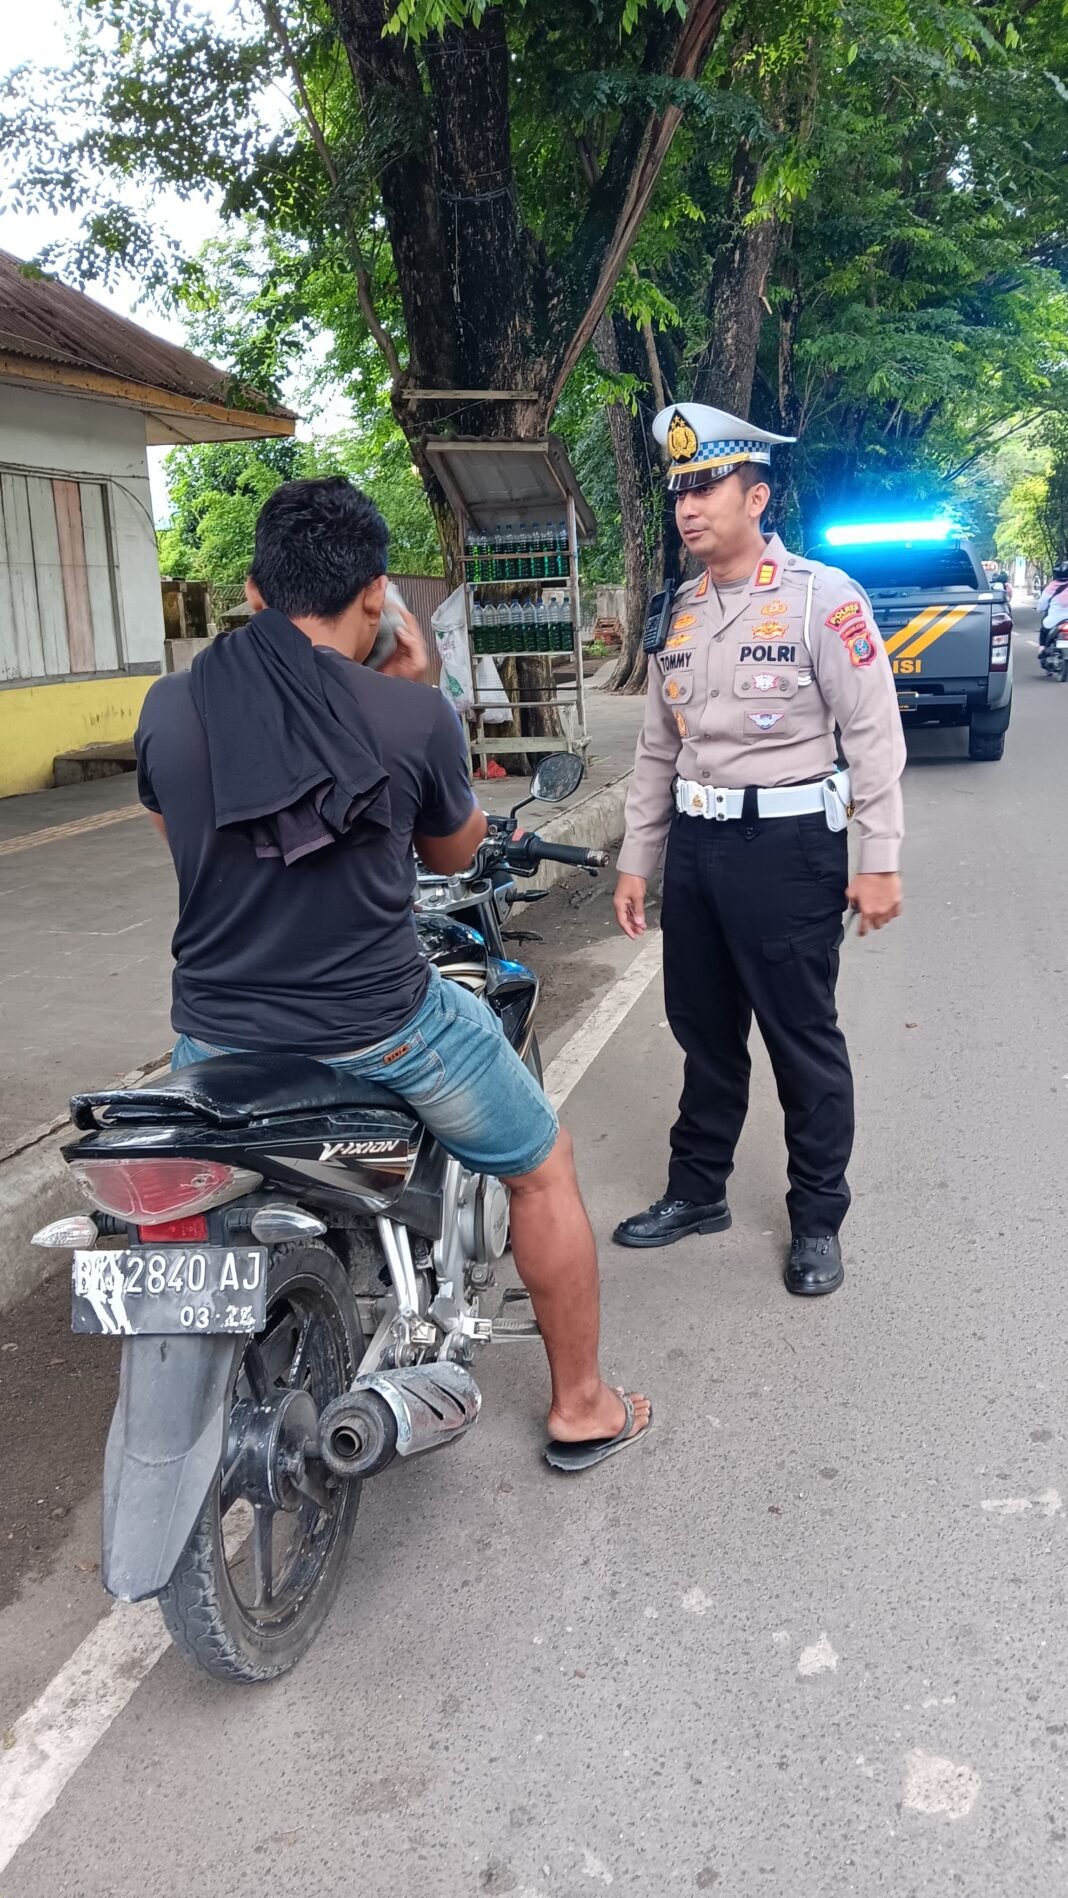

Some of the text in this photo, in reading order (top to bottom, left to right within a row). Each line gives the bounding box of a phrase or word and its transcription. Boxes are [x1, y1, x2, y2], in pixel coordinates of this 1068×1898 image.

[660, 652, 692, 672] TOMMY
[740, 645, 796, 662] POLRI
[893, 659, 922, 673] ISI
[126, 1254, 205, 1294] 2840
[220, 1252, 261, 1291] AJ
